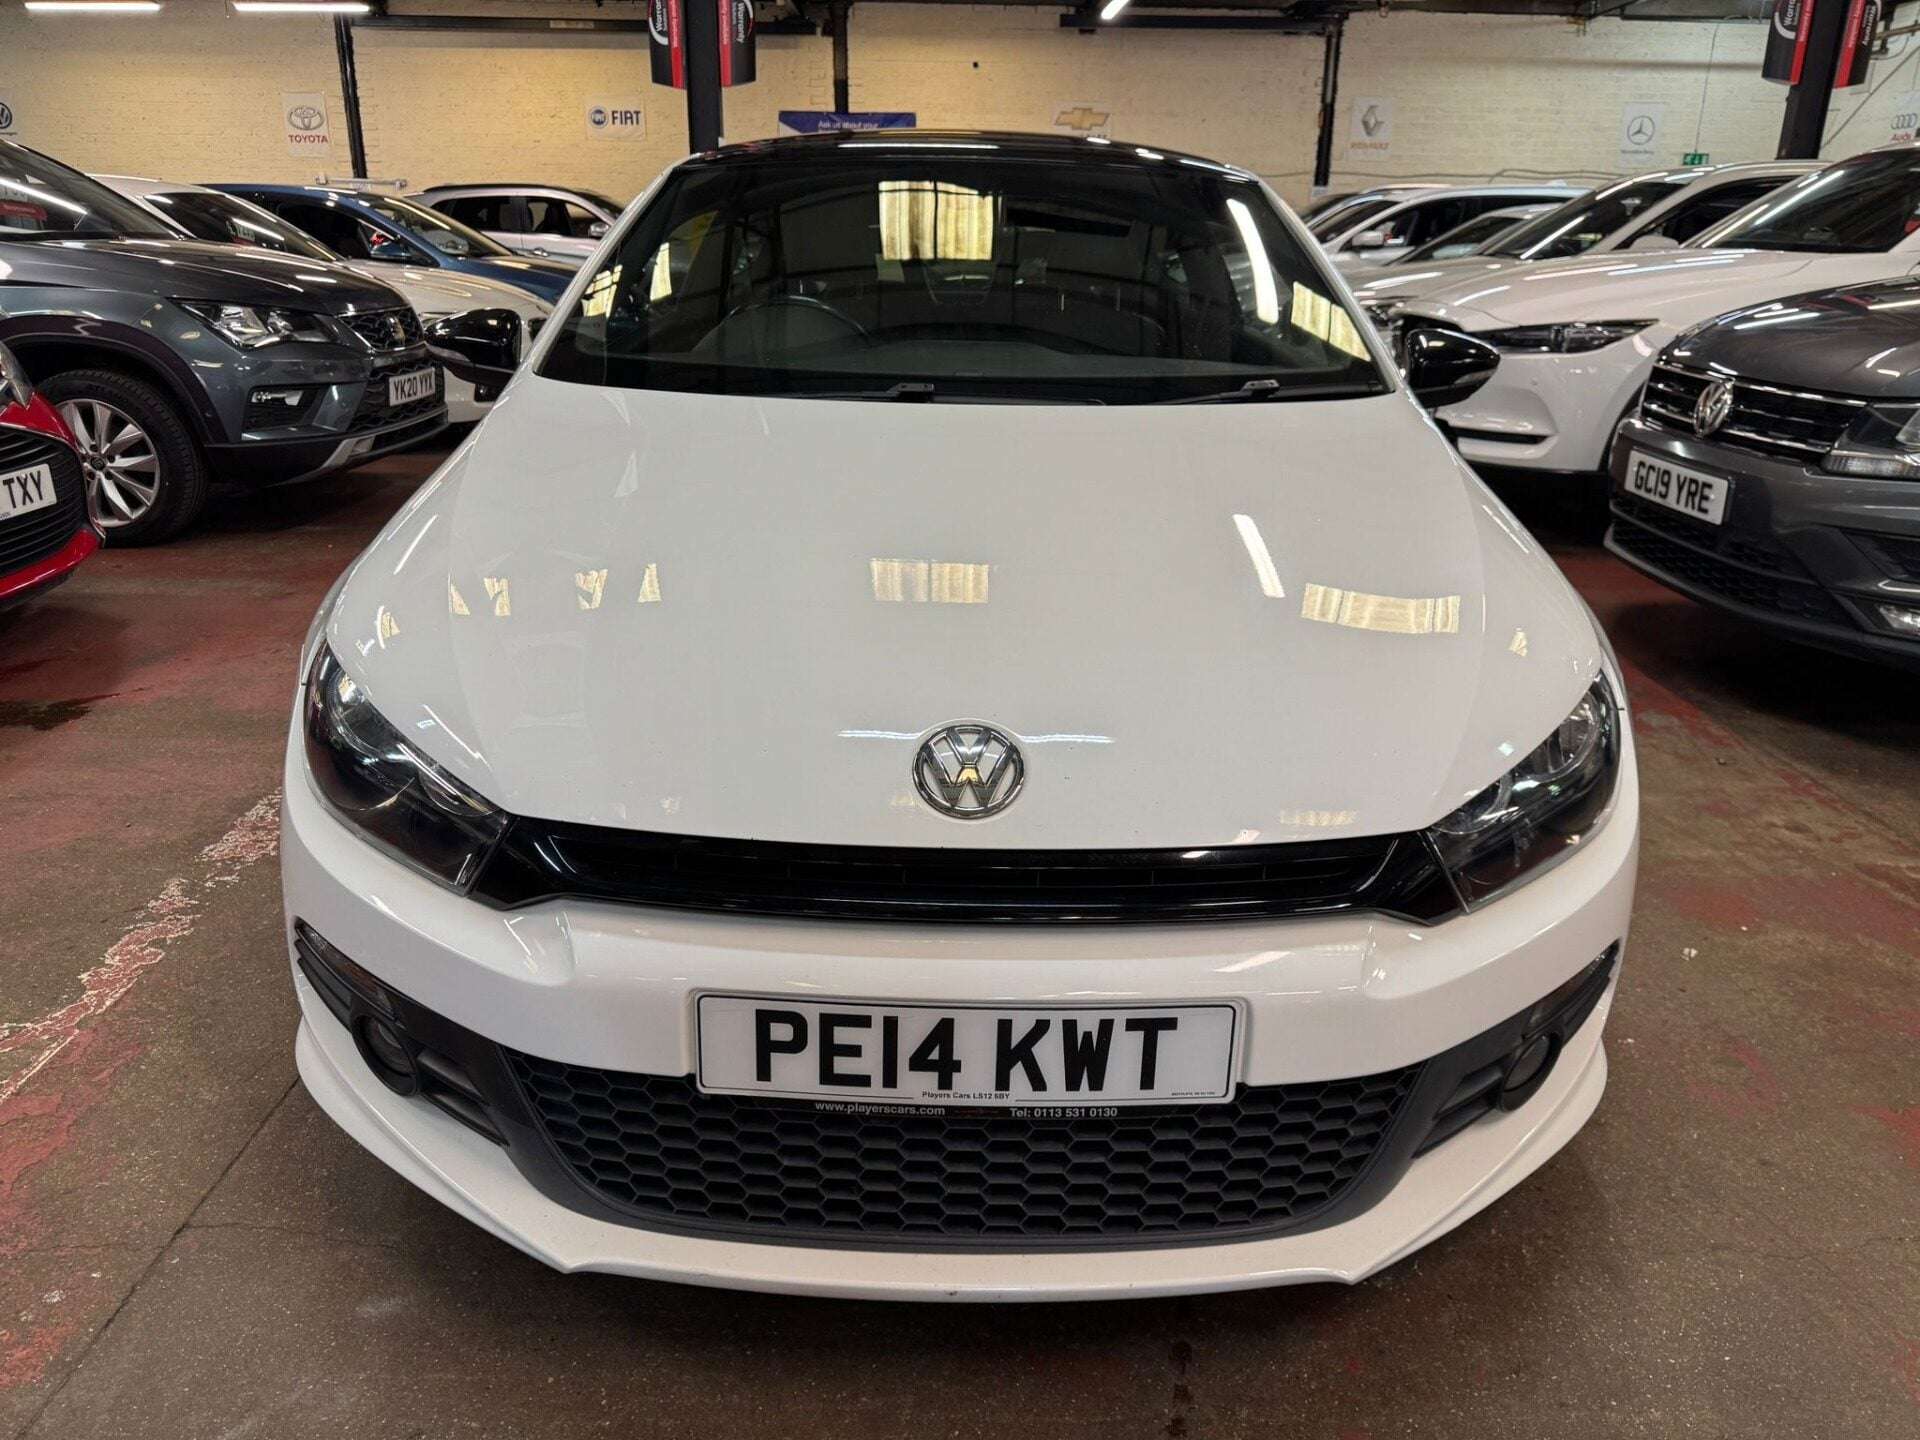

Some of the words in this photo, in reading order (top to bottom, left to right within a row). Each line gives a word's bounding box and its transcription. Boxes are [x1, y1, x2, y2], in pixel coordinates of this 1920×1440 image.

[655, 0, 663, 32] Warran
[736, 2, 745, 43] Warranty
[1783, 0, 1796, 26] Warra
[611, 110, 641, 125] FIAT
[288, 134, 329, 144] TOYOTA
[393, 377, 418, 400] YK20
[2, 470, 44, 509] TXY
[1634, 461, 1672, 500] GC19
[1676, 473, 1713, 515] YRE
[755, 1008, 962, 1091] PE14
[995, 1017, 1179, 1092] KWT
[922, 1090, 951, 1100] Players
[952, 1091, 971, 1100] Cars
[972, 1092, 993, 1101] LS12
[815, 1102, 946, 1116] www.playerscars.com
[1009, 1107, 1031, 1118] Tel:
[1034, 1107, 1062, 1118] 0113
[1065, 1107, 1086, 1118] 531
[1089, 1107, 1118, 1118] 0130
